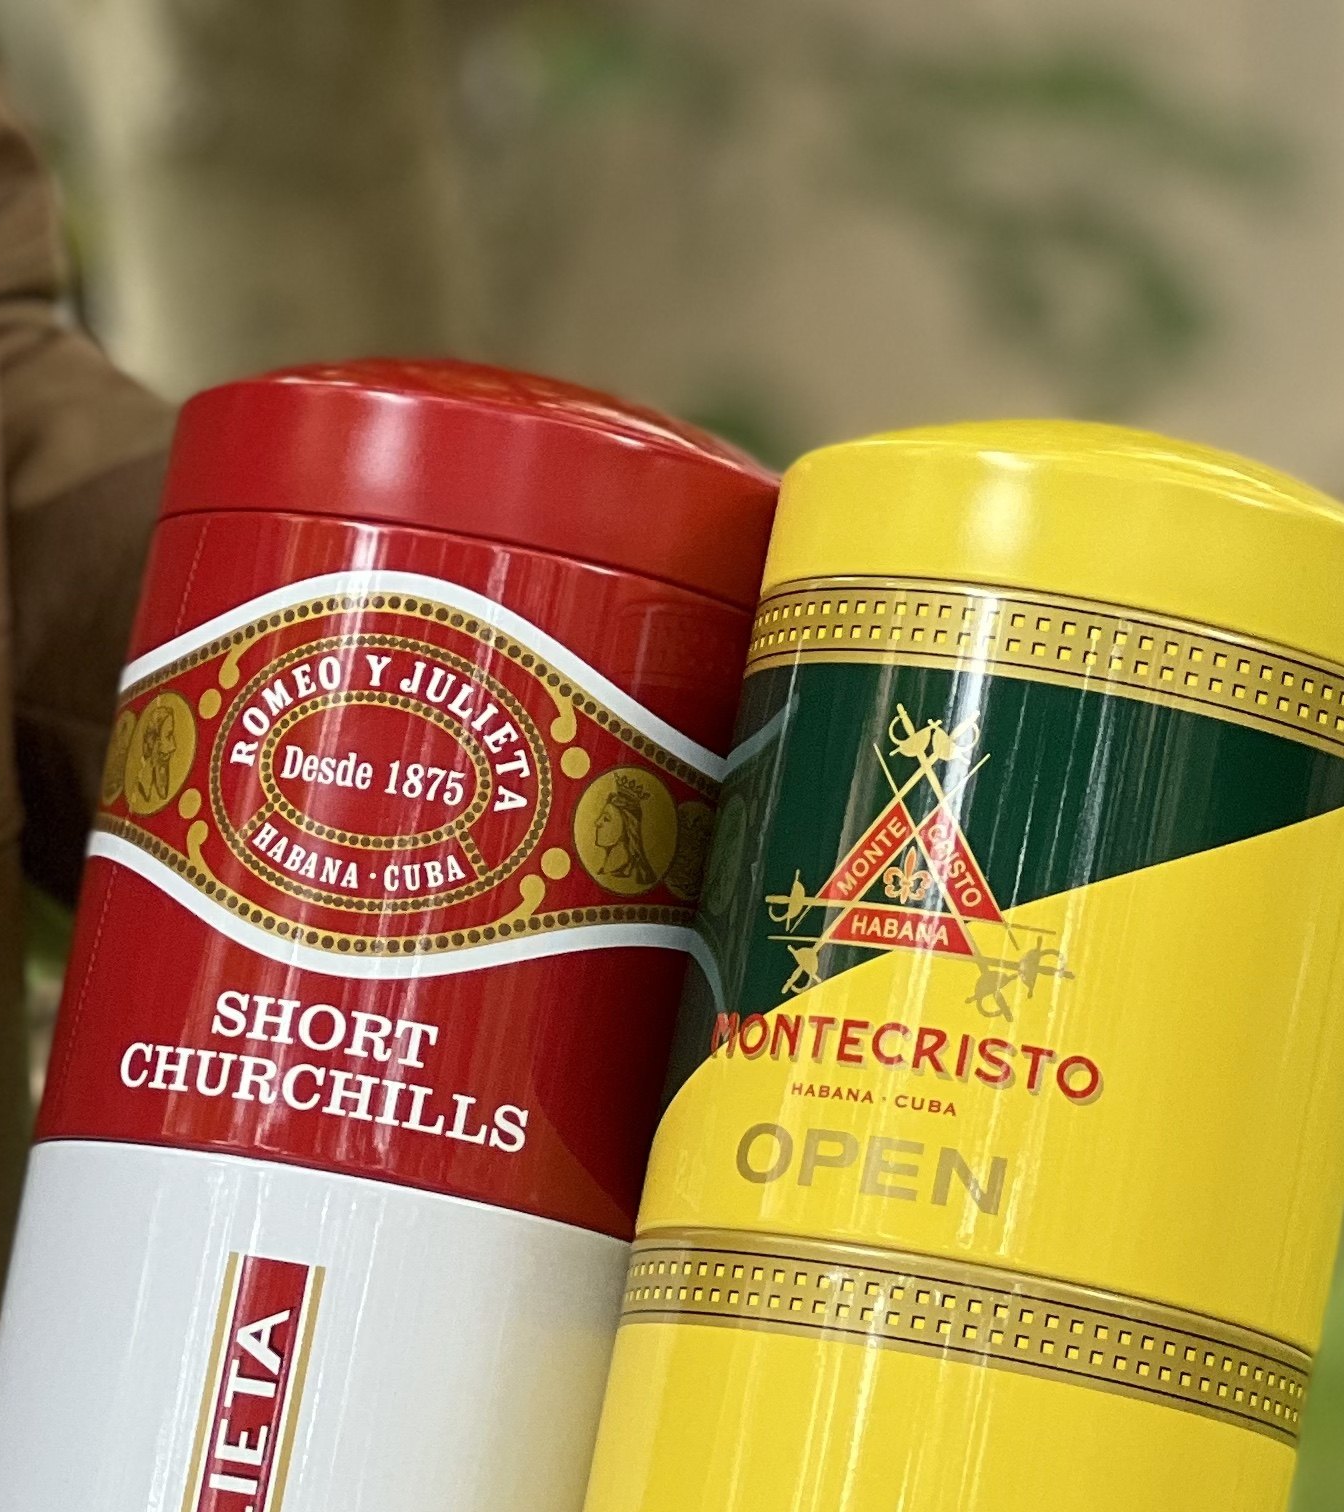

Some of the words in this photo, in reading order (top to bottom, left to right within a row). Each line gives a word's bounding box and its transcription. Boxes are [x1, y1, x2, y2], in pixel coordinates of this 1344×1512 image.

[230, 655, 341, 767] ROMEO
[365, 654, 392, 687] Y
[400, 661, 530, 812] JULIETA
[280, 744, 374, 790] Desde
[384, 759, 465, 806] 1875
[252, 822, 358, 889] HABANA
[384, 854, 466, 891] CUBA
[836, 816, 906, 896] MONTE
[850, 914, 949, 946] HABANA
[210, 990, 438, 1069] SHORT
[711, 1011, 1104, 1106] MONTECRISTO
[119, 1041, 528, 1153] CHURCHILLS
[791, 1082, 874, 1104] HABANA
[894, 1095, 957, 1117] CUBA
[736, 1122, 1008, 1216] OPEN
